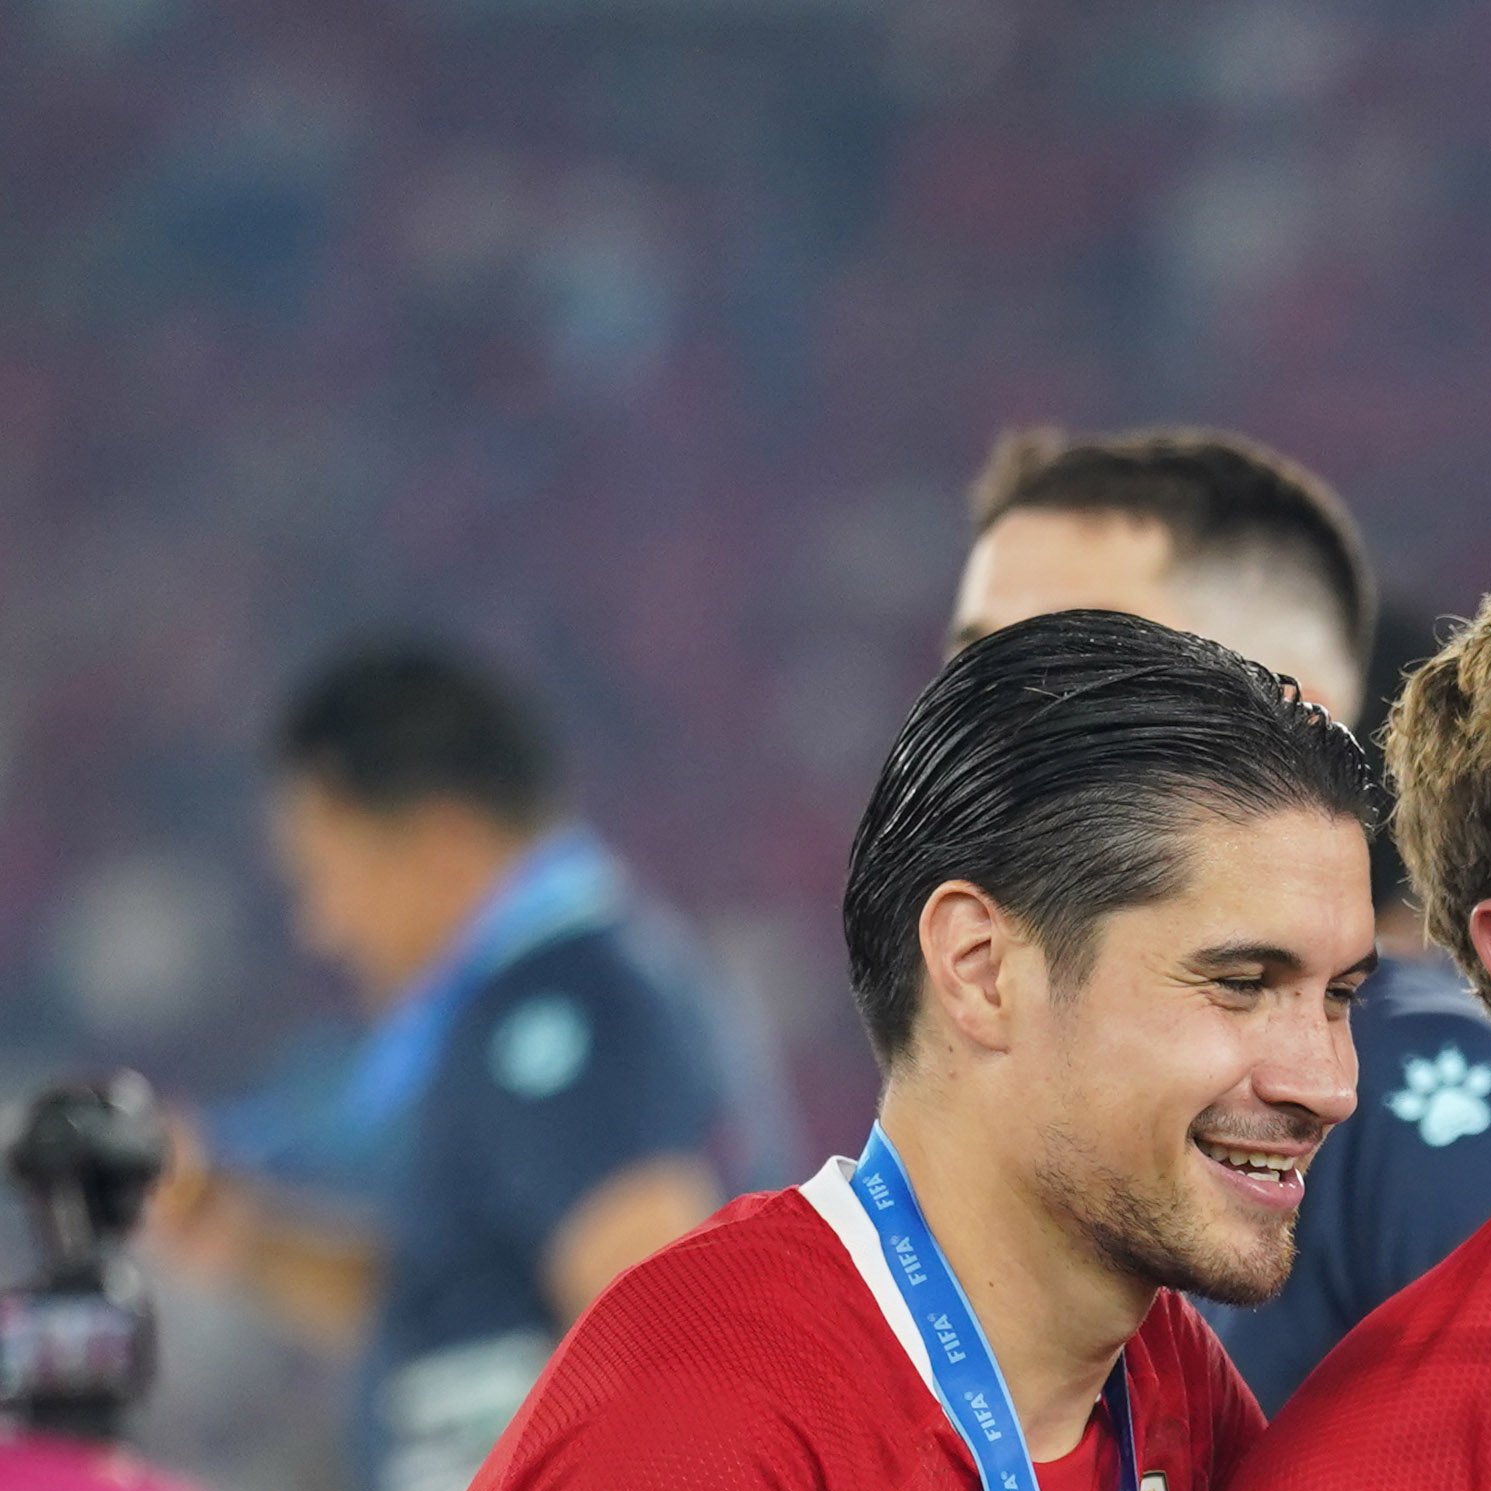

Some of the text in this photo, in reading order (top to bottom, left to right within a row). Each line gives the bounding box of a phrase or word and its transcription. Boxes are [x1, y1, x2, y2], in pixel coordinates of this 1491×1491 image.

[867, 1172, 894, 1211] FIFA
[896, 1236, 928, 1287] FIFA
[933, 1313, 966, 1365] FIFA
[971, 1391, 1002, 1442] FIFA
